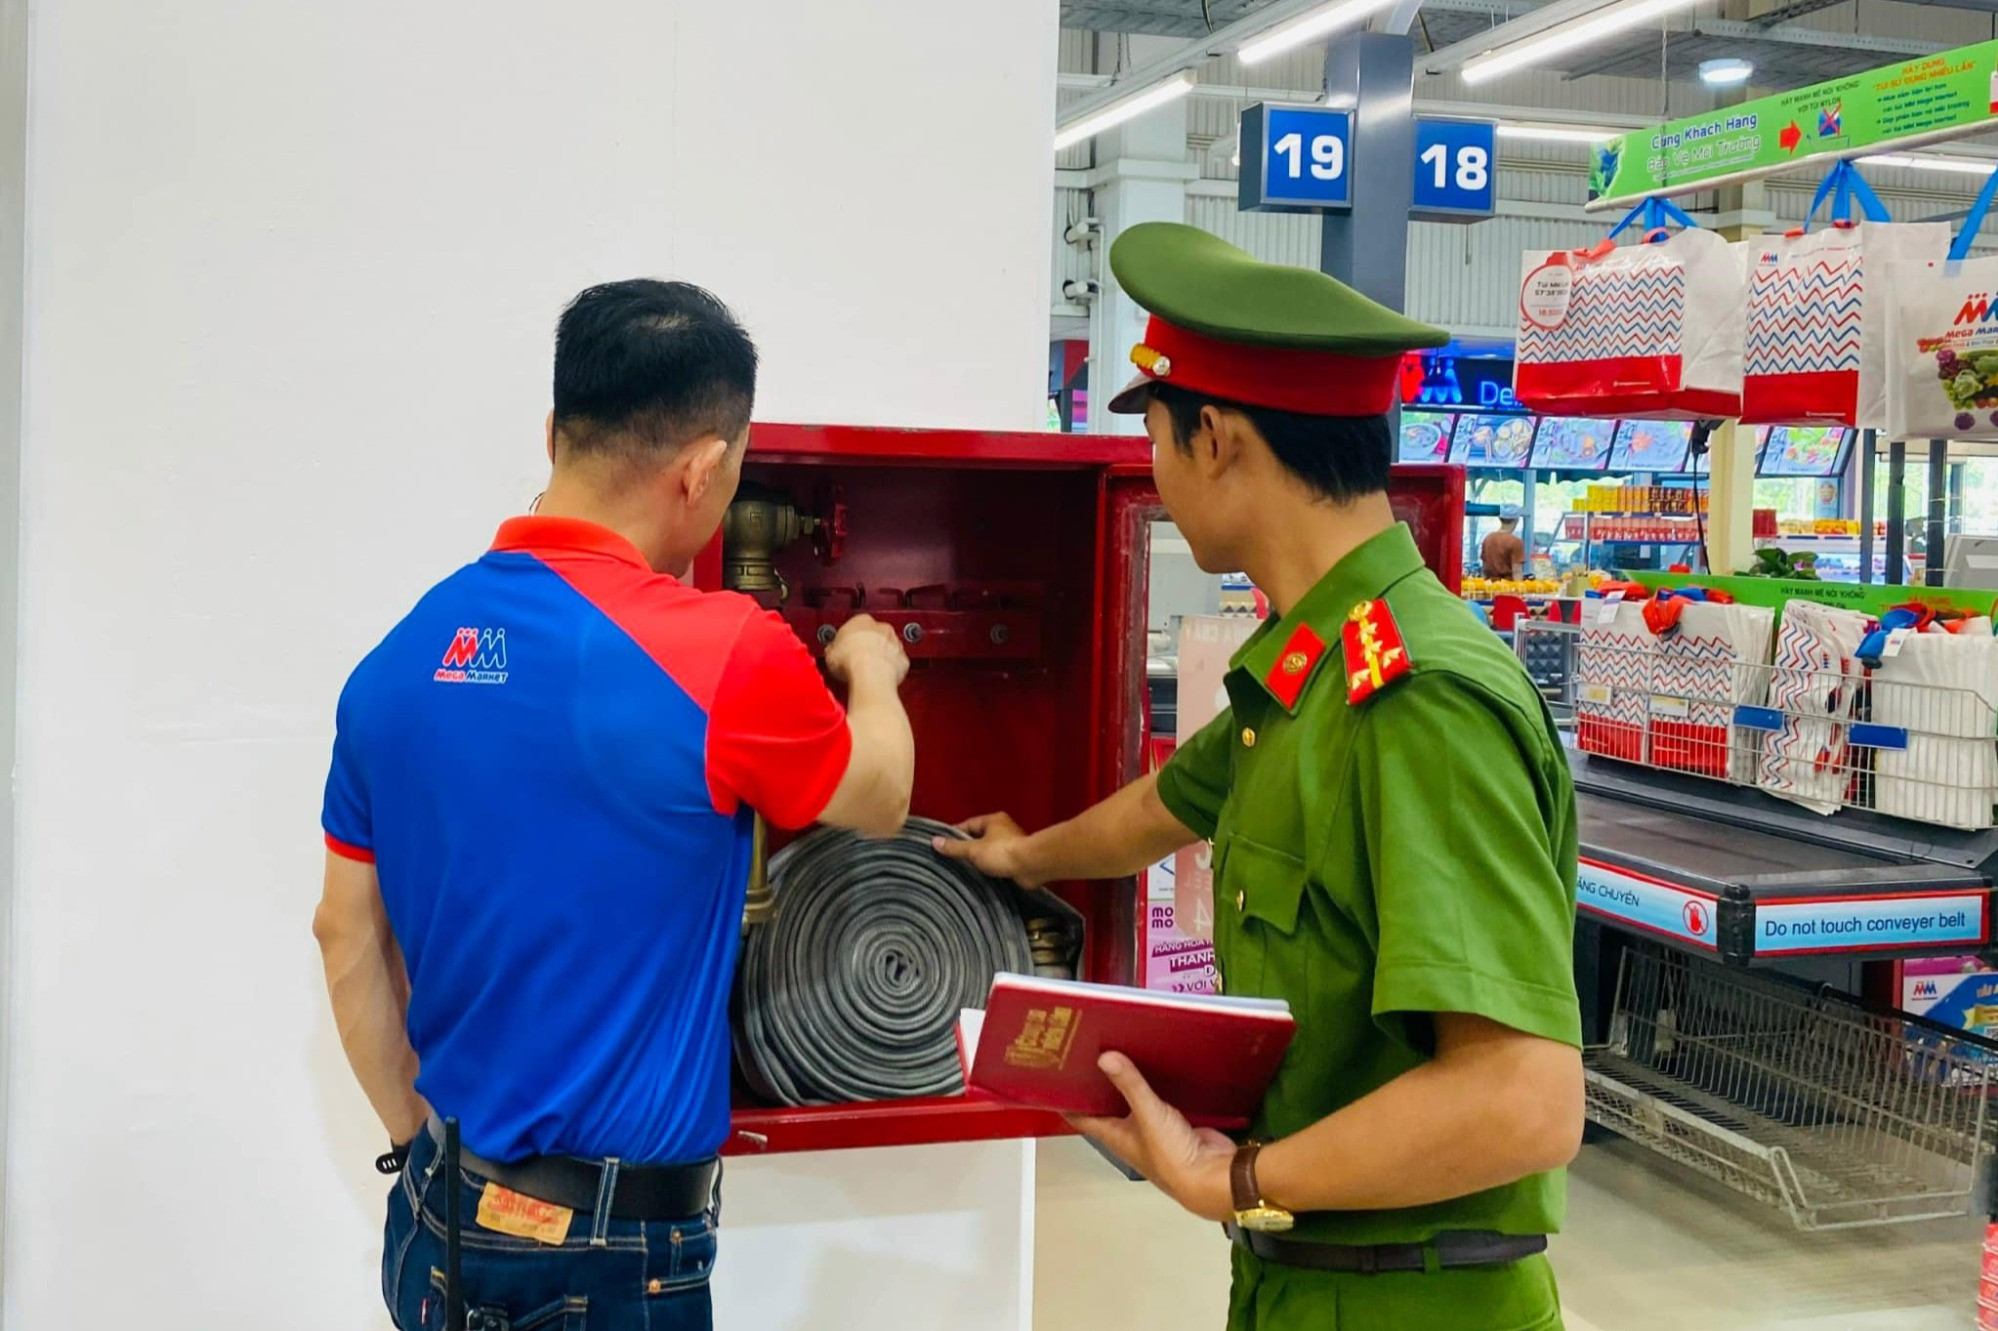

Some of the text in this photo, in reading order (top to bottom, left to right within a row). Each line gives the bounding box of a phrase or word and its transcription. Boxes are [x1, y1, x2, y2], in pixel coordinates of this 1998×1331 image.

[1274, 133, 1343, 180] 19
[1420, 144, 1487, 191] 18
[1765, 911, 1966, 937] Do not touch conveyer belt
